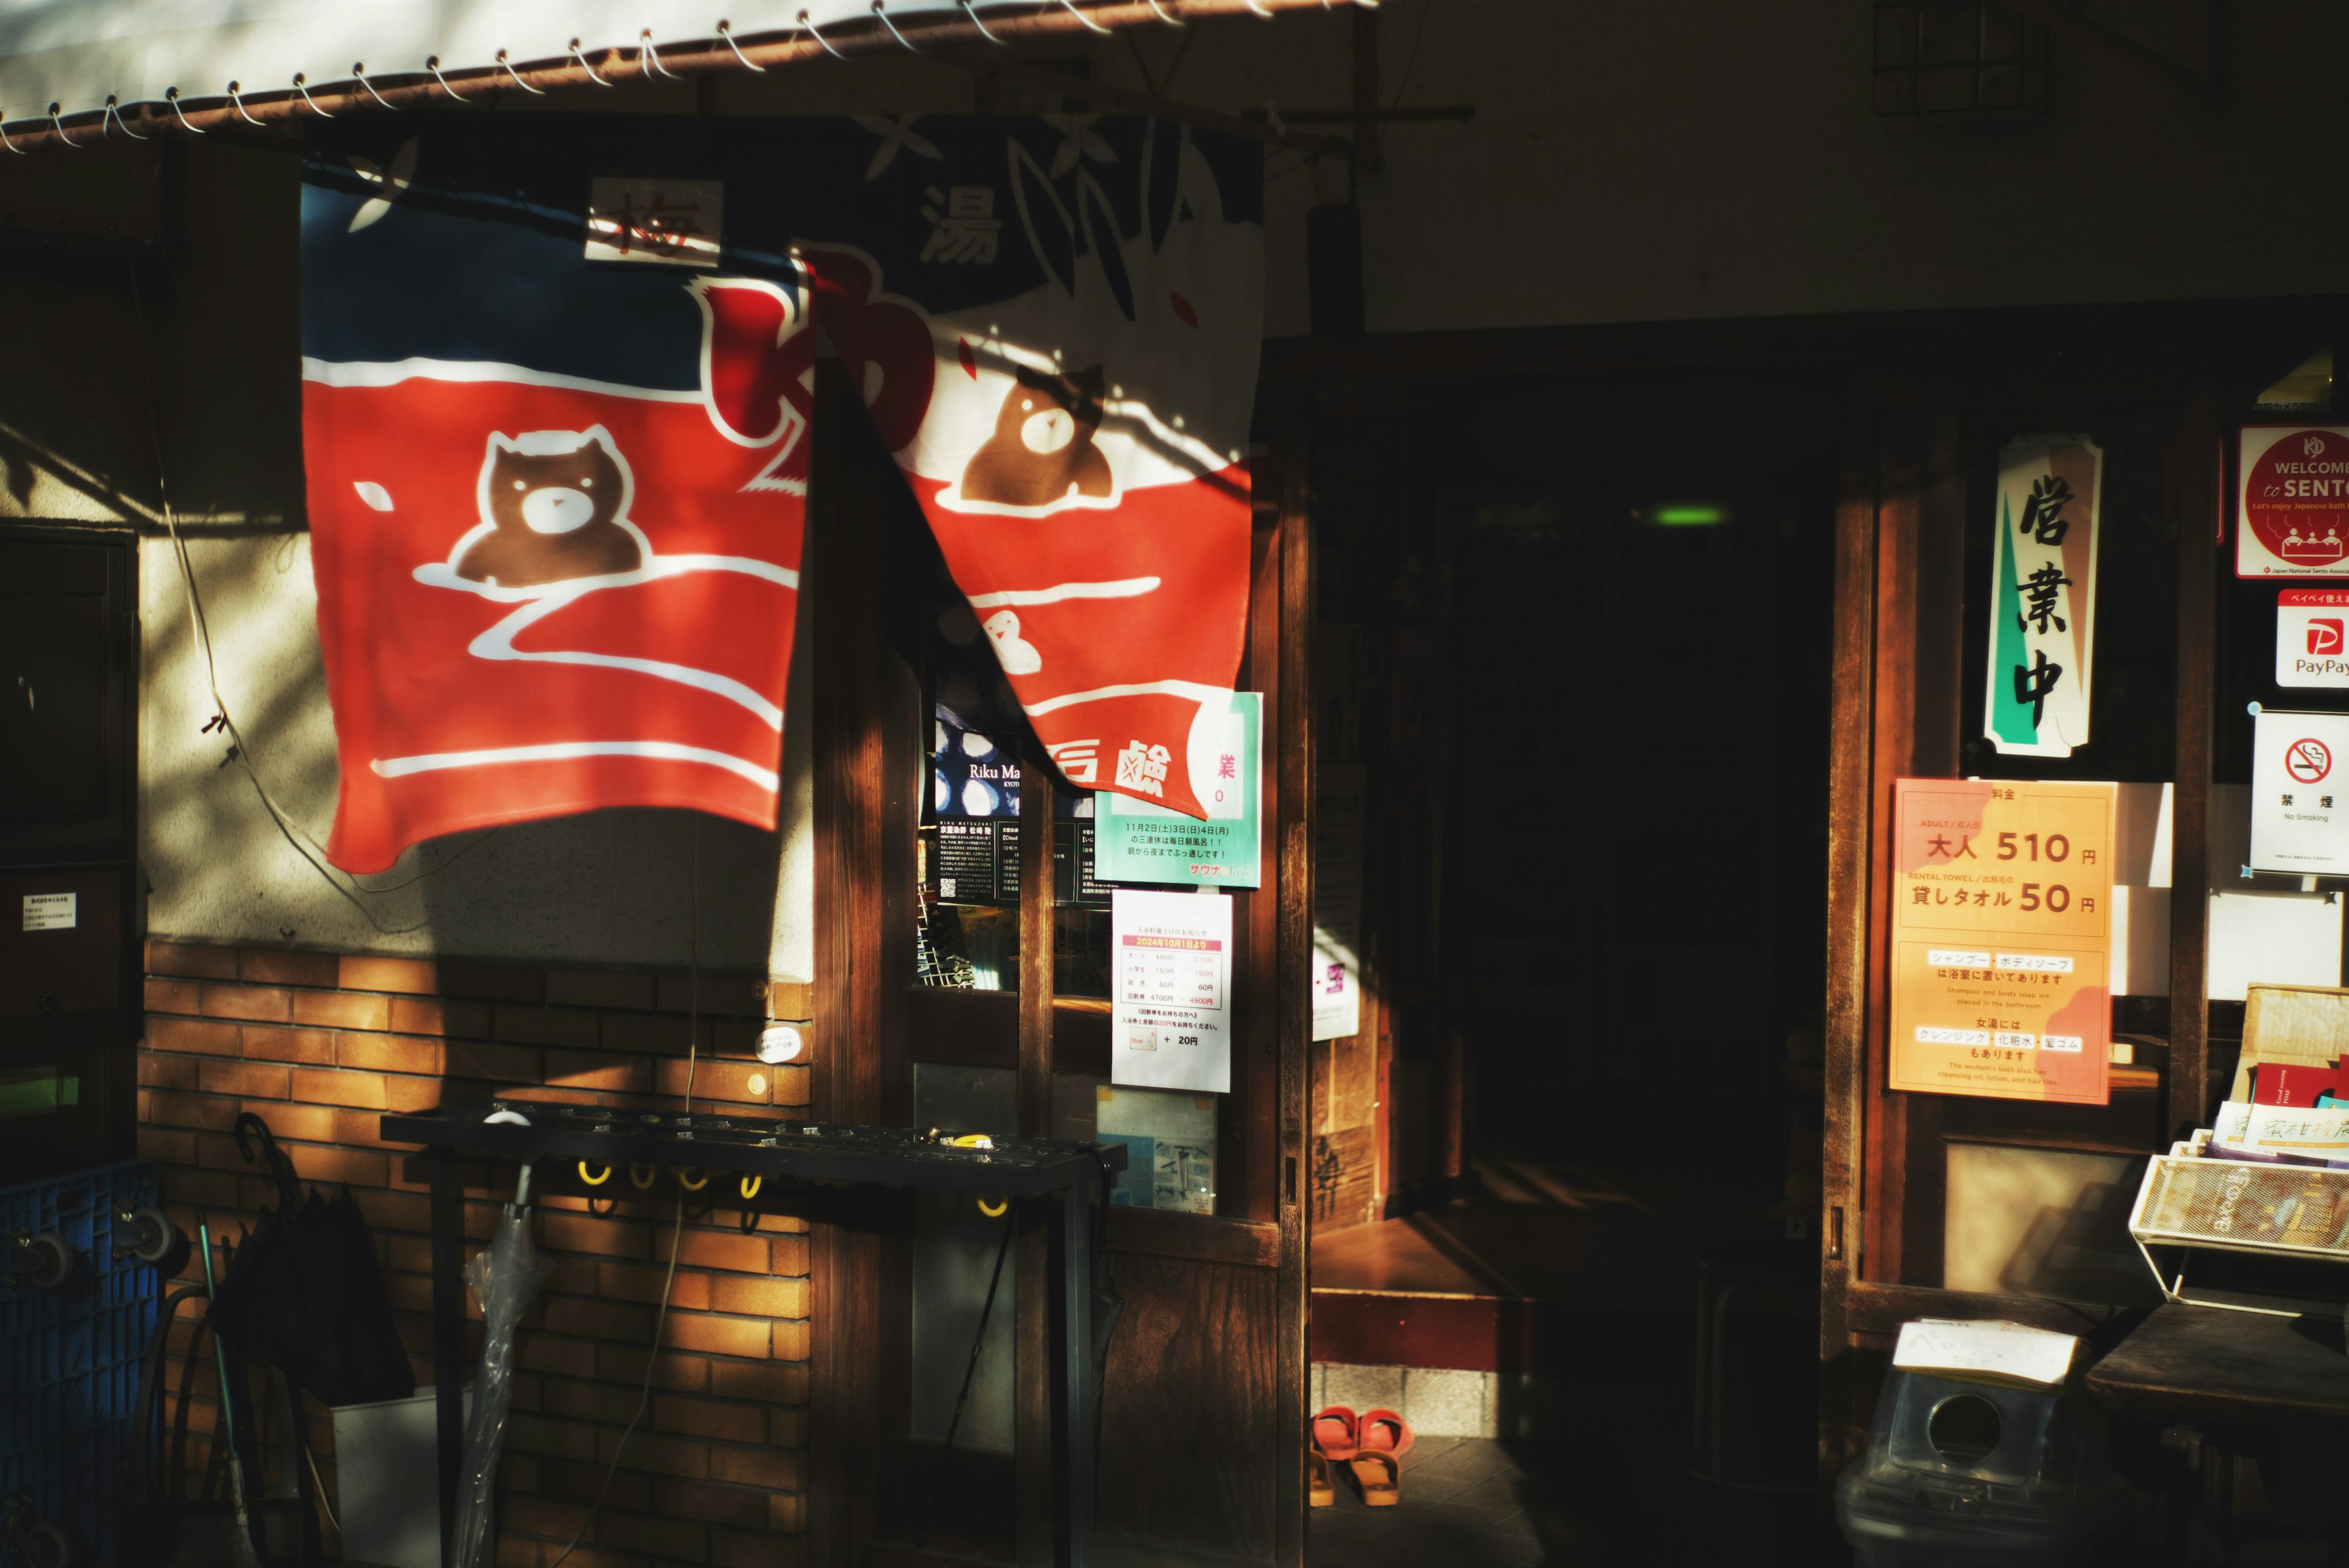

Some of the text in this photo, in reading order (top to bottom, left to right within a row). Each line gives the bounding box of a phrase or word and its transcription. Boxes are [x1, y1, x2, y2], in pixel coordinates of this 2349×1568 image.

[606, 185, 1001, 265] 梅 湯
[2275, 462, 2349, 475] WELCOME
[2263, 479, 2349, 497] to SENT
[2014, 474, 2074, 731] 営業中
[970, 764, 998, 778] Riku
[1992, 788, 2015, 800] 料金
[2296, 814, 2328, 823] Smoking
[1126, 823, 1229, 836] 11月2日(土)3日(日)4日(月)
[1132, 835, 1221, 847] の三連休は毎日朝風呂！！
[1127, 847, 1225, 859] 朝から夜までぶっ通しです！
[1928, 832, 2096, 865] 大人 510 円
[1908, 872, 1940, 881] RENTAL
[1912, 882, 2095, 913] 貸しタオル 50 円
[1137, 926, 1207, 937] 入浴料値上げのお知らせ
[1137, 937, 1206, 949] 2024年10月1日より
[1938, 969, 2062, 985] は浴室に置いてあります
[1998, 989, 2016, 998] body
[1122, 1017, 1217, 1031] 入浴券と差額の20円をお持ちください。
[1976, 1017, 2021, 1030] 女湯には
[1178, 1036, 1198, 1046] 20円
[1971, 1047, 2025, 1062] もあります
[1938, 1071, 1972, 1081] cleansing
